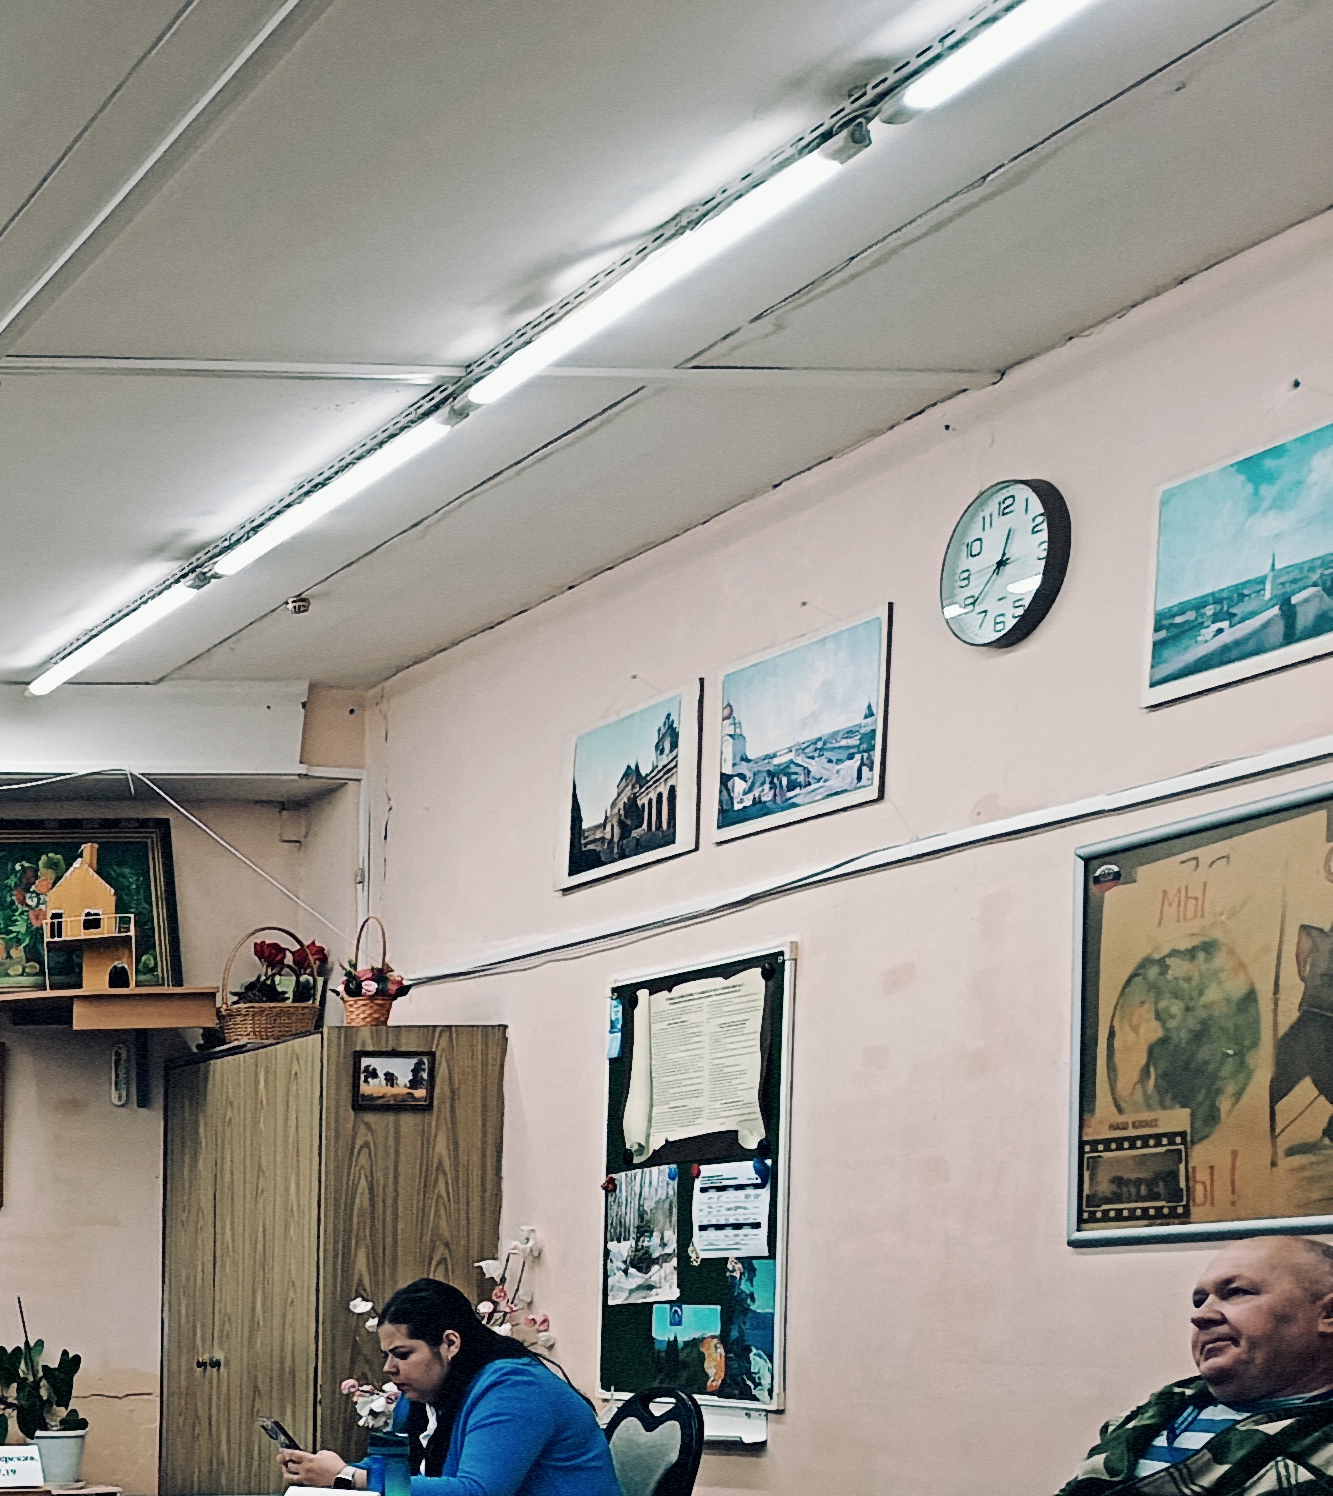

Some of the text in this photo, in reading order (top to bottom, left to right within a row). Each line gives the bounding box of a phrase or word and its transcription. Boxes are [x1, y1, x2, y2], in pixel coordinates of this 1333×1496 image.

[997, 494, 1016, 518] 12
[1024, 497, 1030, 515] 1
[981, 512, 993, 532] 11
[1031, 511, 1046, 535] 2
[965, 537, 983, 559] 10
[958, 568, 971, 588] 9
[1013, 598, 1025, 619] 5
[976, 609, 988, 630] 7
[993, 613, 1006, 632] 6
[1157, 880, 1208, 927] МЫ
